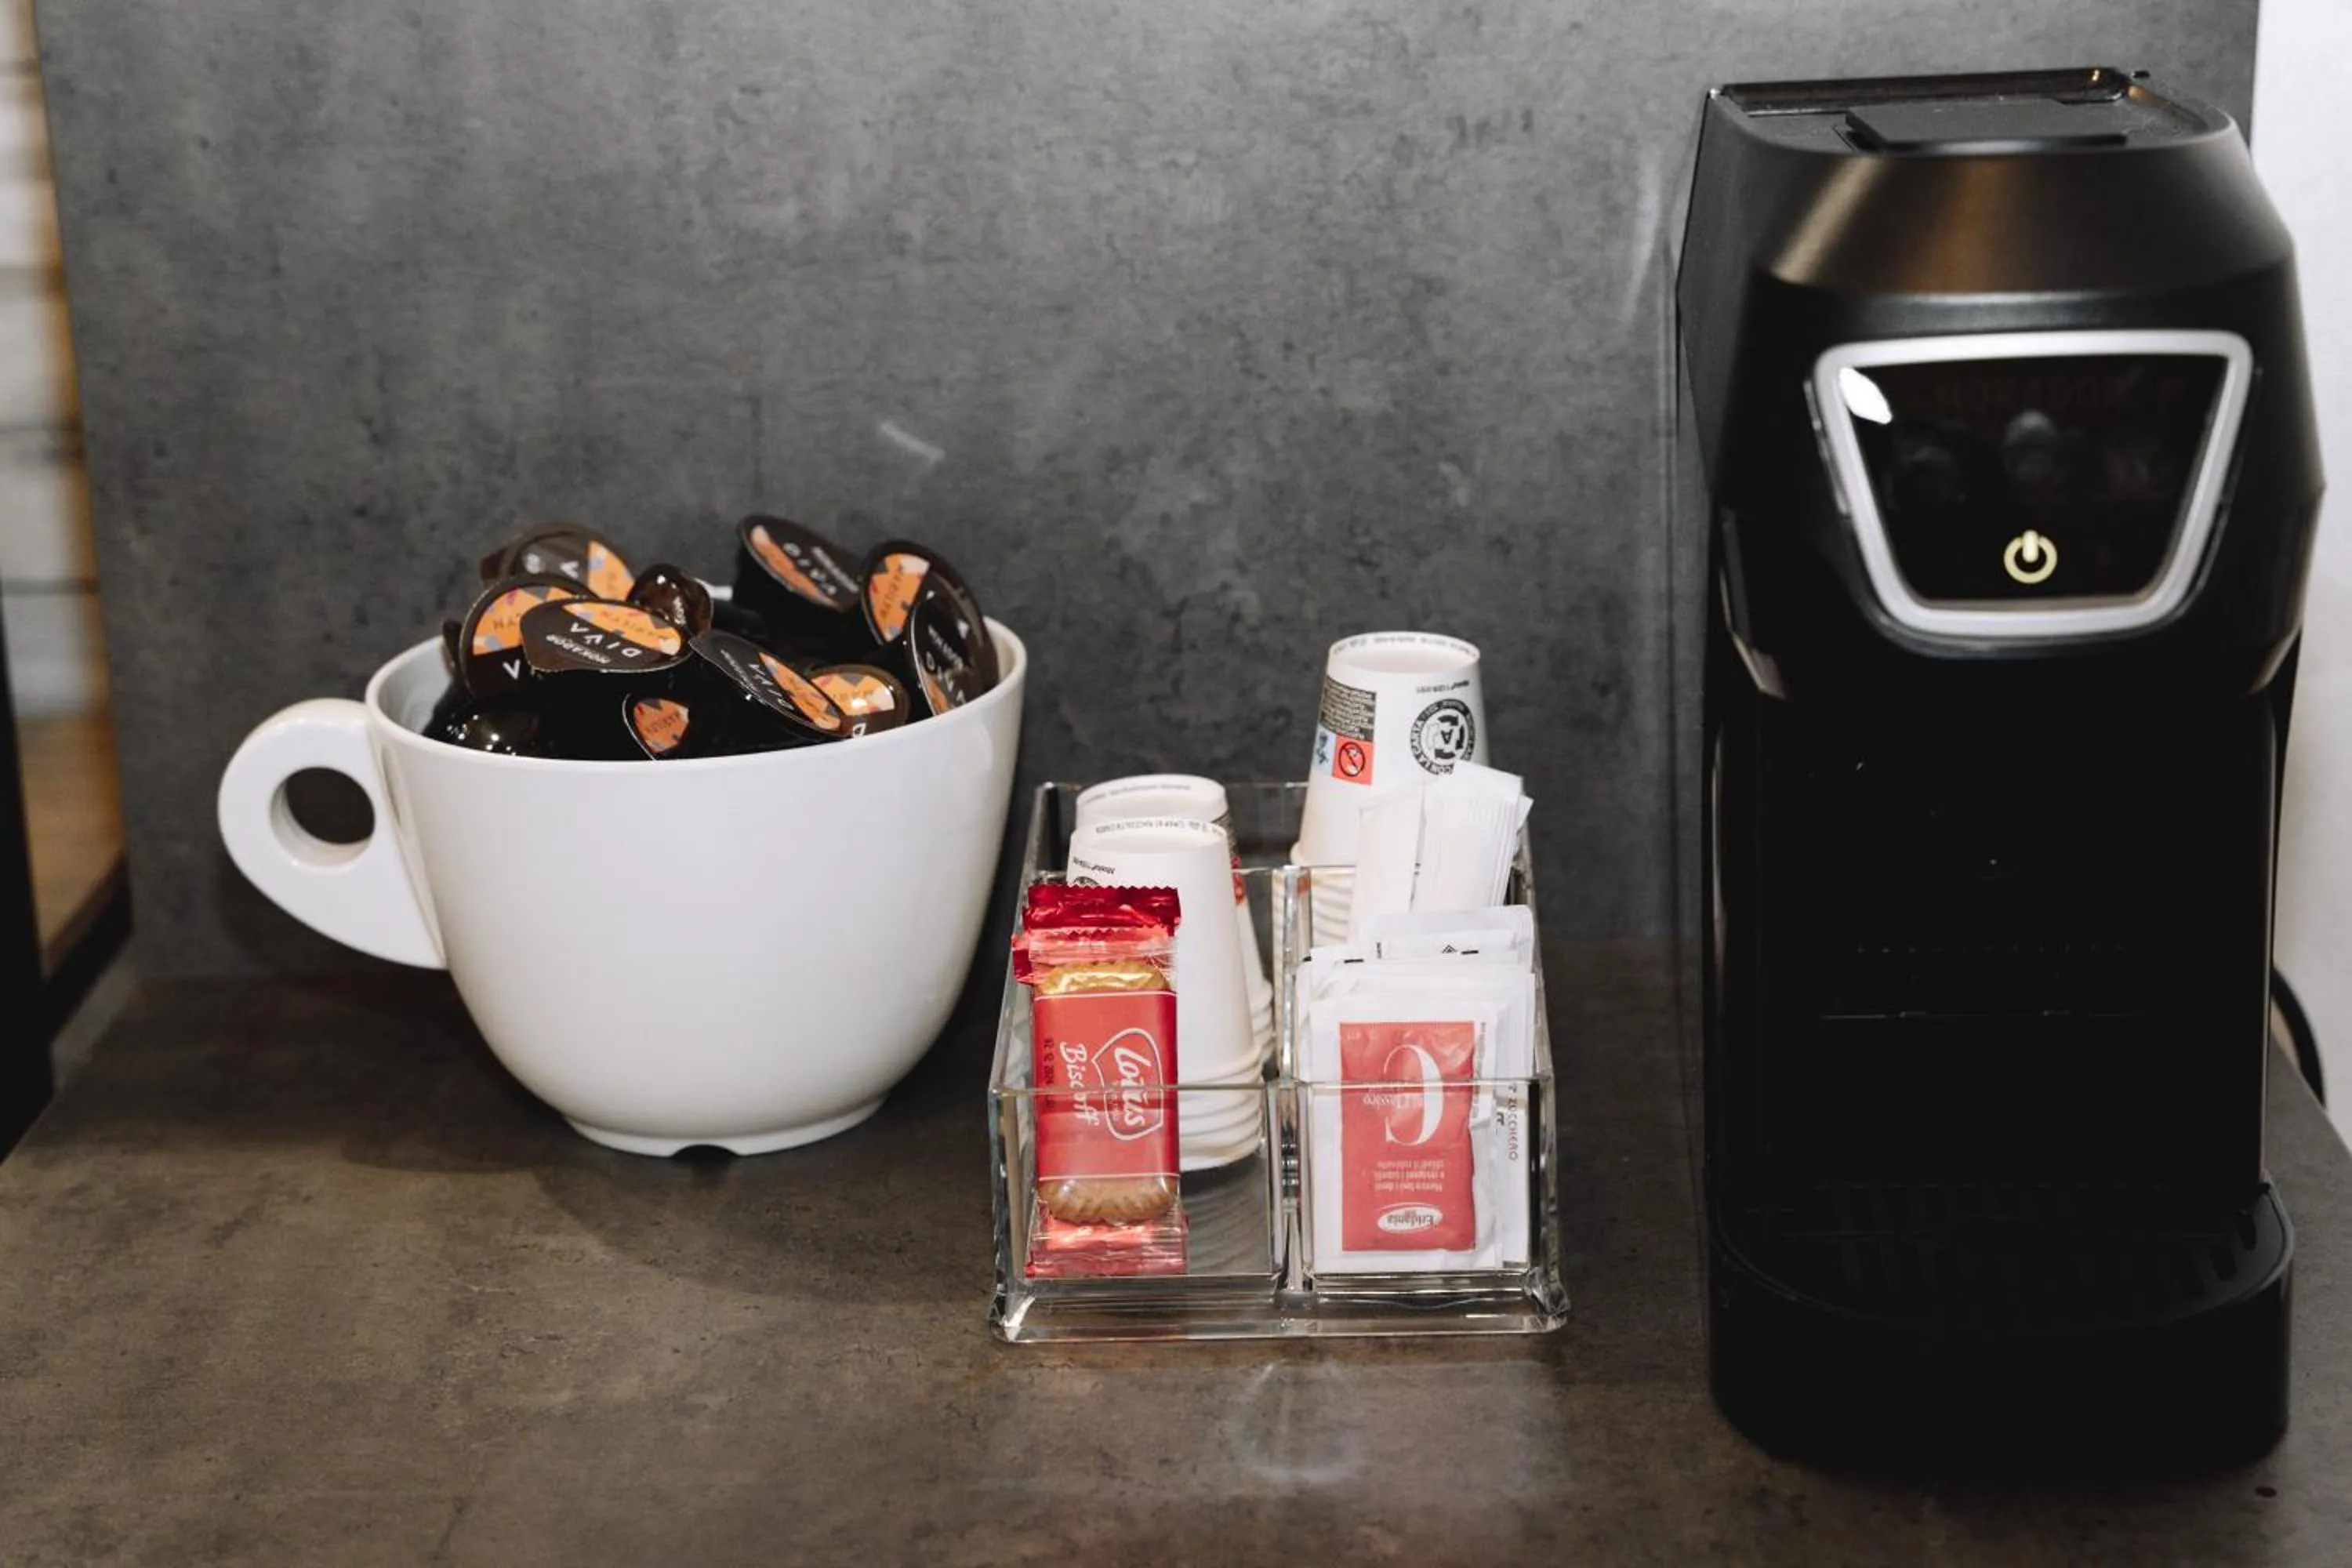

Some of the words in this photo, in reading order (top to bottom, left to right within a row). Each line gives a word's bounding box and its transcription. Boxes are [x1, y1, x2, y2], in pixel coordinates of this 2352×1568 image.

[571, 622, 642, 659] DIVA
[1059, 1041, 1099, 1127] Biscoff
[1114, 1047, 1152, 1127] Lotus
